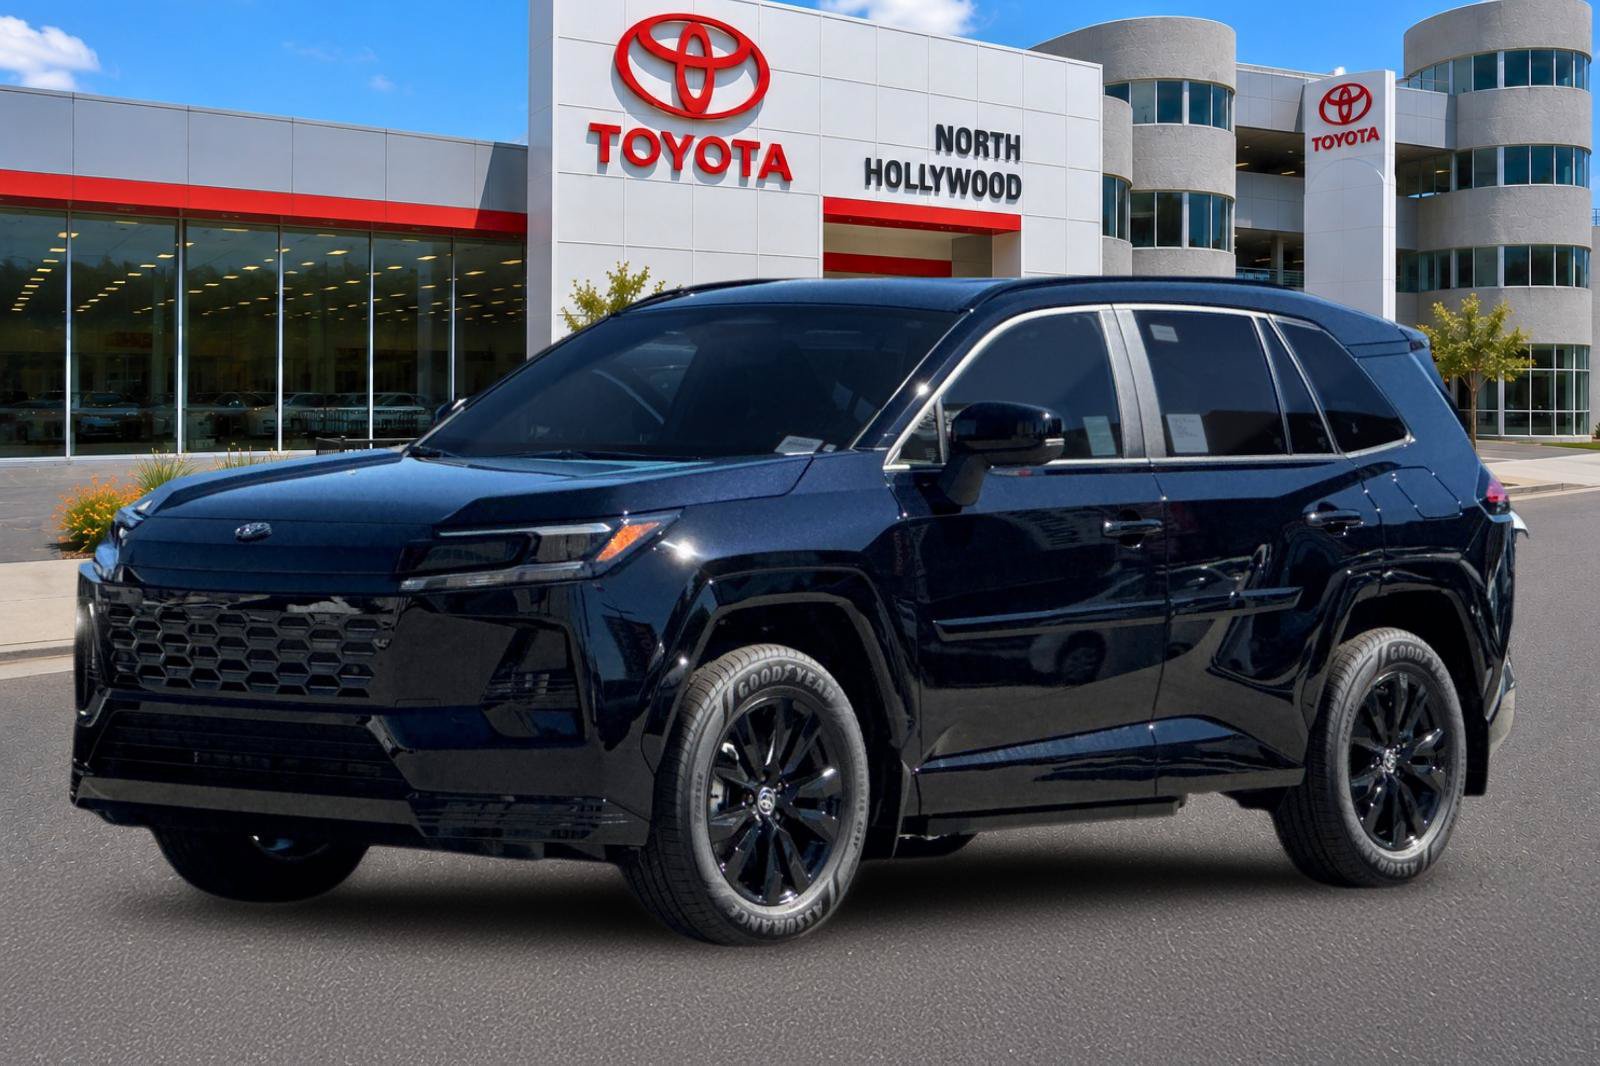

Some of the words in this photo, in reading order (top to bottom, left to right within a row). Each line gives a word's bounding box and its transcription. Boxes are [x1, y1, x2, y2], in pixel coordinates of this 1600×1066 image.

[589, 122, 793, 182] TOYOTA
[935, 124, 1021, 161] NORTH
[1311, 126, 1380, 152] TOYOTA
[864, 157, 1022, 201] HOLLYWOOD
[738, 663, 836, 701] GOODYEAR
[726, 899, 823, 936] ASSURANCE
